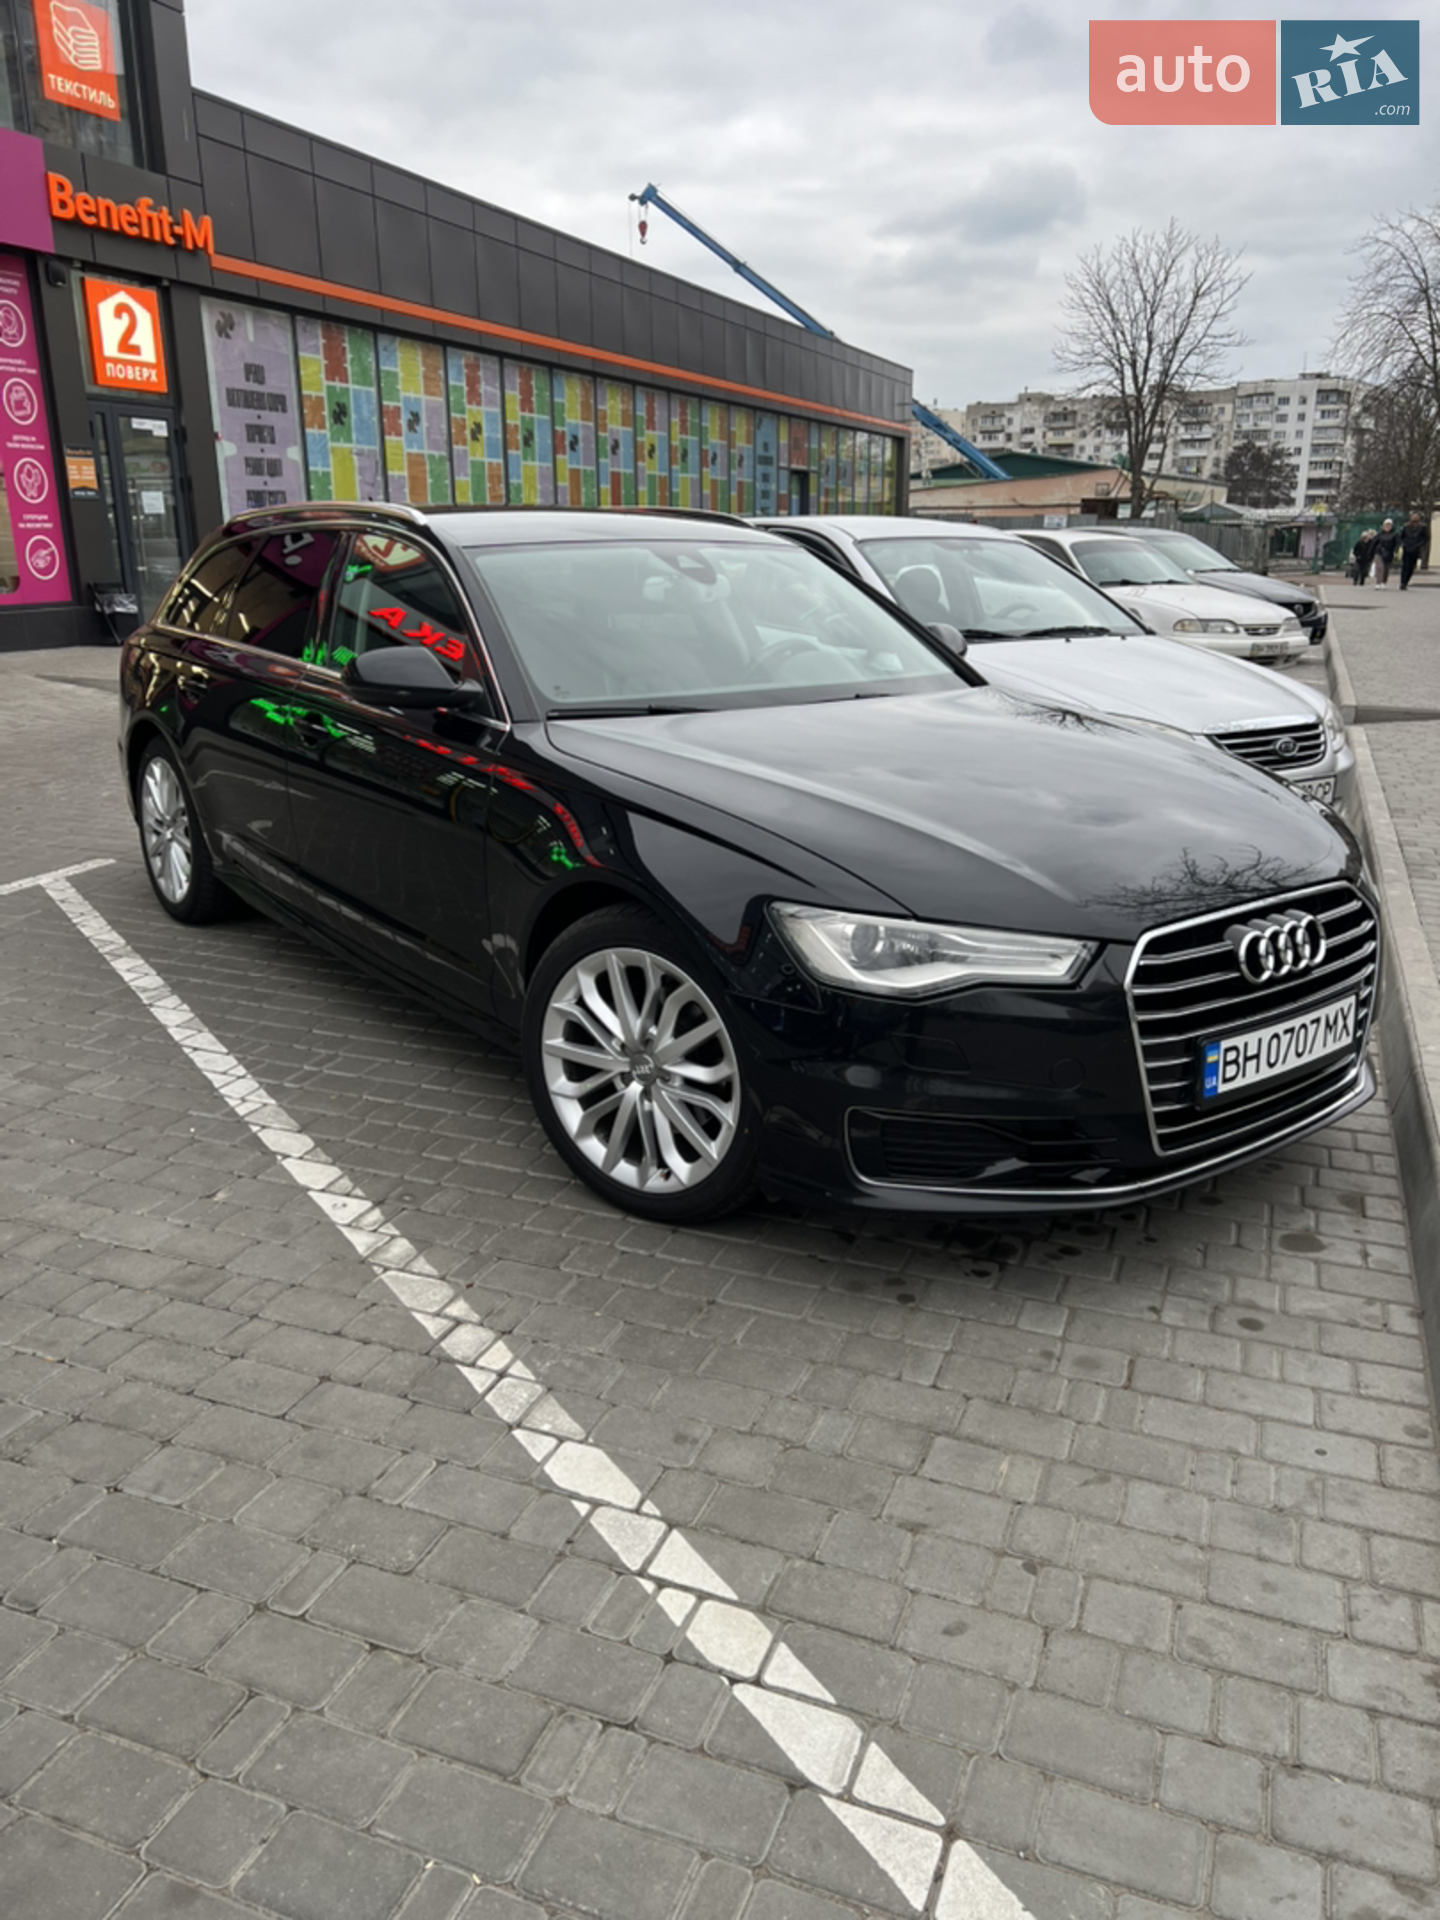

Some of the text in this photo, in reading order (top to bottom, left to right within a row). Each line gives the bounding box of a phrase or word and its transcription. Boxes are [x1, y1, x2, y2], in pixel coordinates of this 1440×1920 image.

[47, 73, 117, 110] ТЕКСТИЛЬ
[46, 171, 215, 256] Benefit-M
[112, 302, 142, 357] 2
[105, 362, 159, 383] ПОВЕРХ
